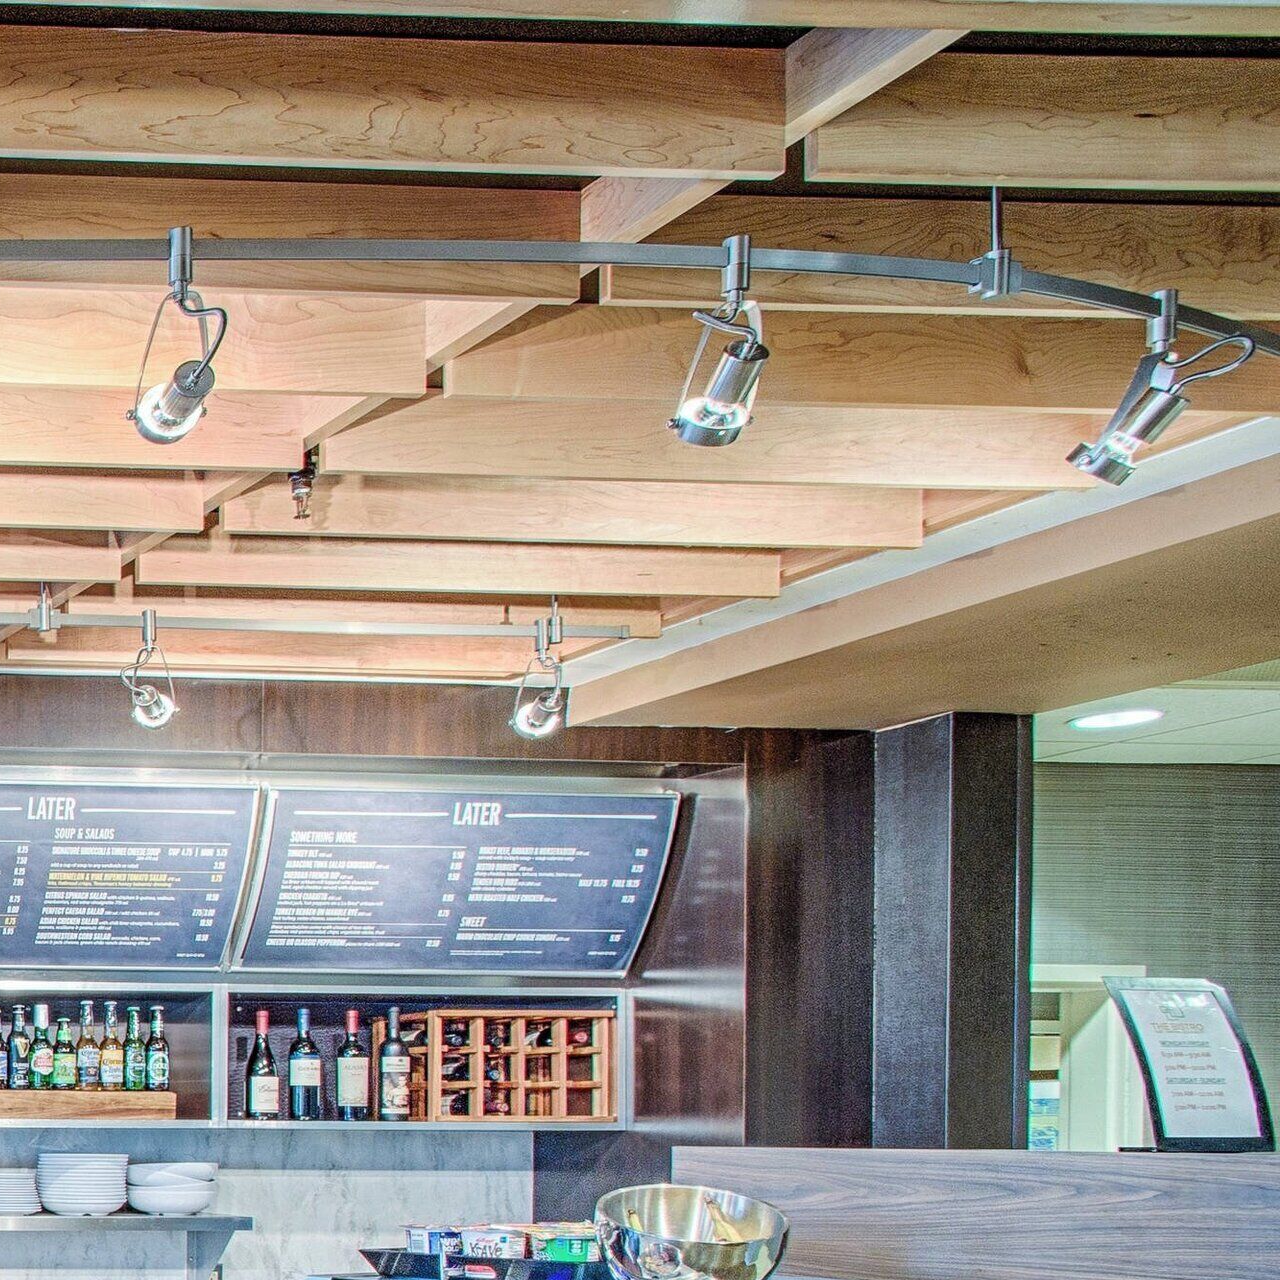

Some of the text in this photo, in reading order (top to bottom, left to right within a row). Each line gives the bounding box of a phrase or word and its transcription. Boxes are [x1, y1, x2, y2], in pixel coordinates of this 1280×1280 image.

[27, 797, 76, 821] LATER
[453, 803, 502, 827] LATER
[54, 828, 115, 840] SOUP & SALADS
[290, 831, 358, 843] SOMETHING MORE
[459, 916, 487, 927] SWEET
